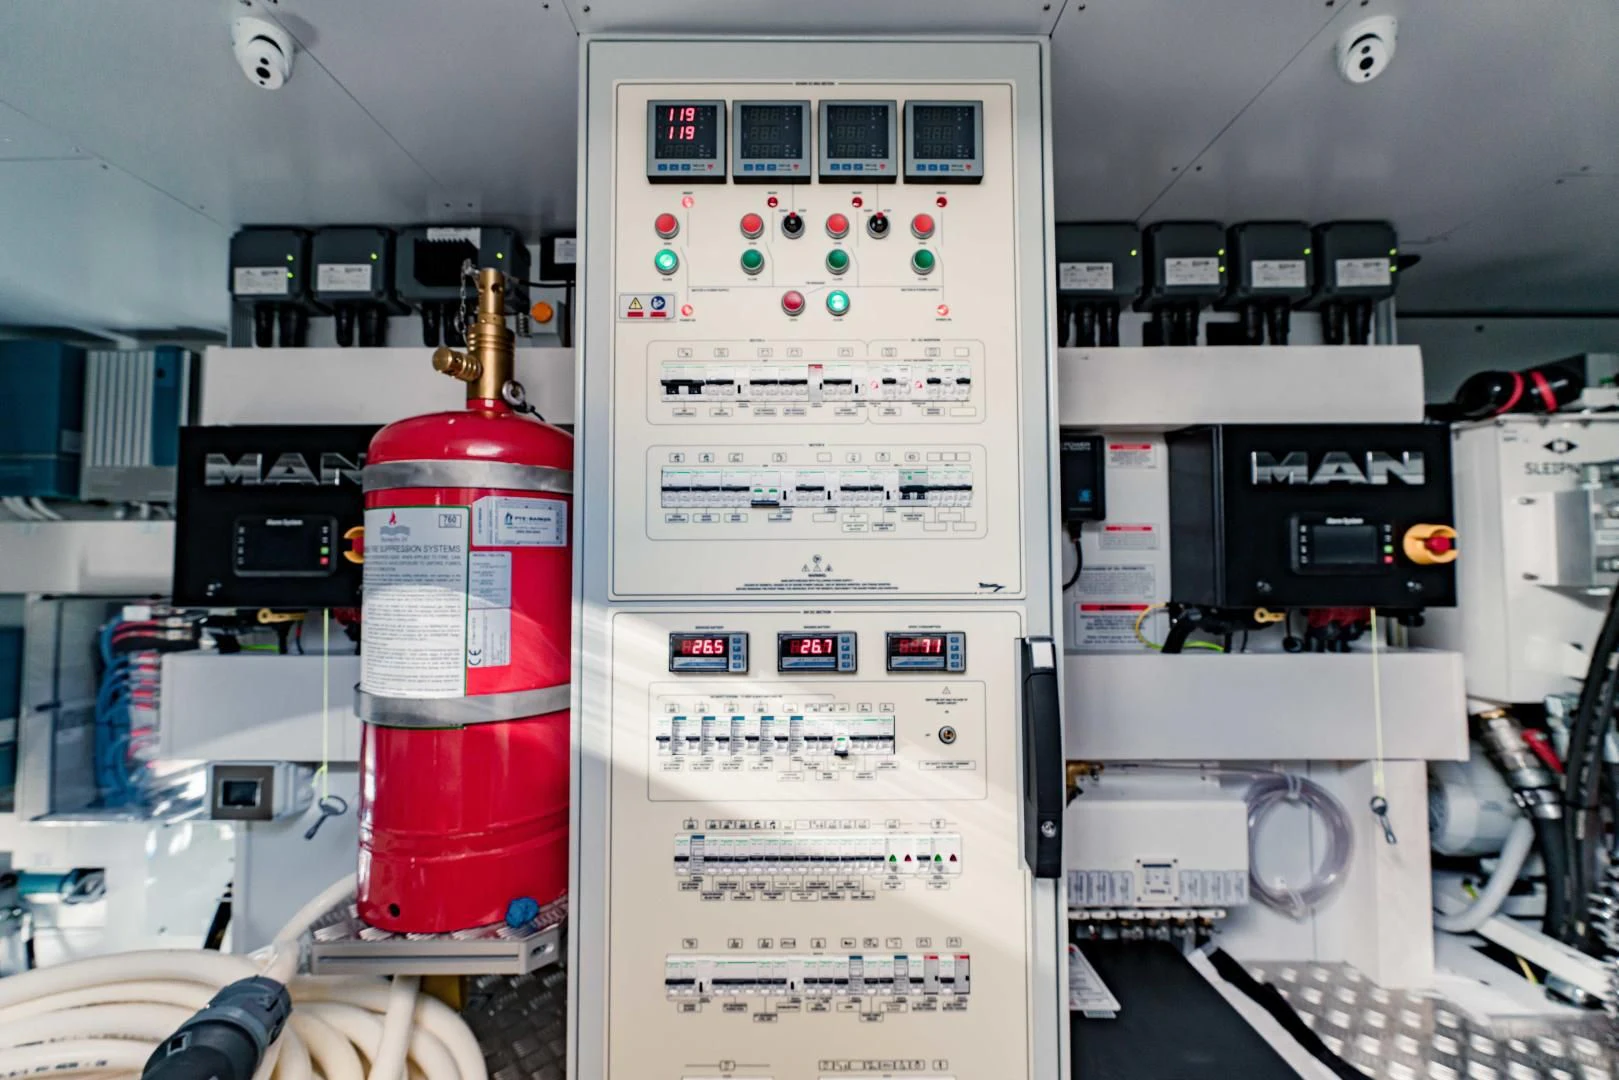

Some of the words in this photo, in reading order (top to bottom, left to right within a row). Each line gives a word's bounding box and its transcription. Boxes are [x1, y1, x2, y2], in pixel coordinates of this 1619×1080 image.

[669, 107, 695, 122] 119
[669, 126, 695, 140] 119
[205, 453, 366, 486] MAN
[1250, 451, 1425, 486] MAN
[444, 514, 457, 523] 760
[423, 545, 461, 553] SYSTEMS
[692, 639, 724, 654] 26.5
[800, 639, 833, 654] 26.7
[923, 639, 941, 653] 71
